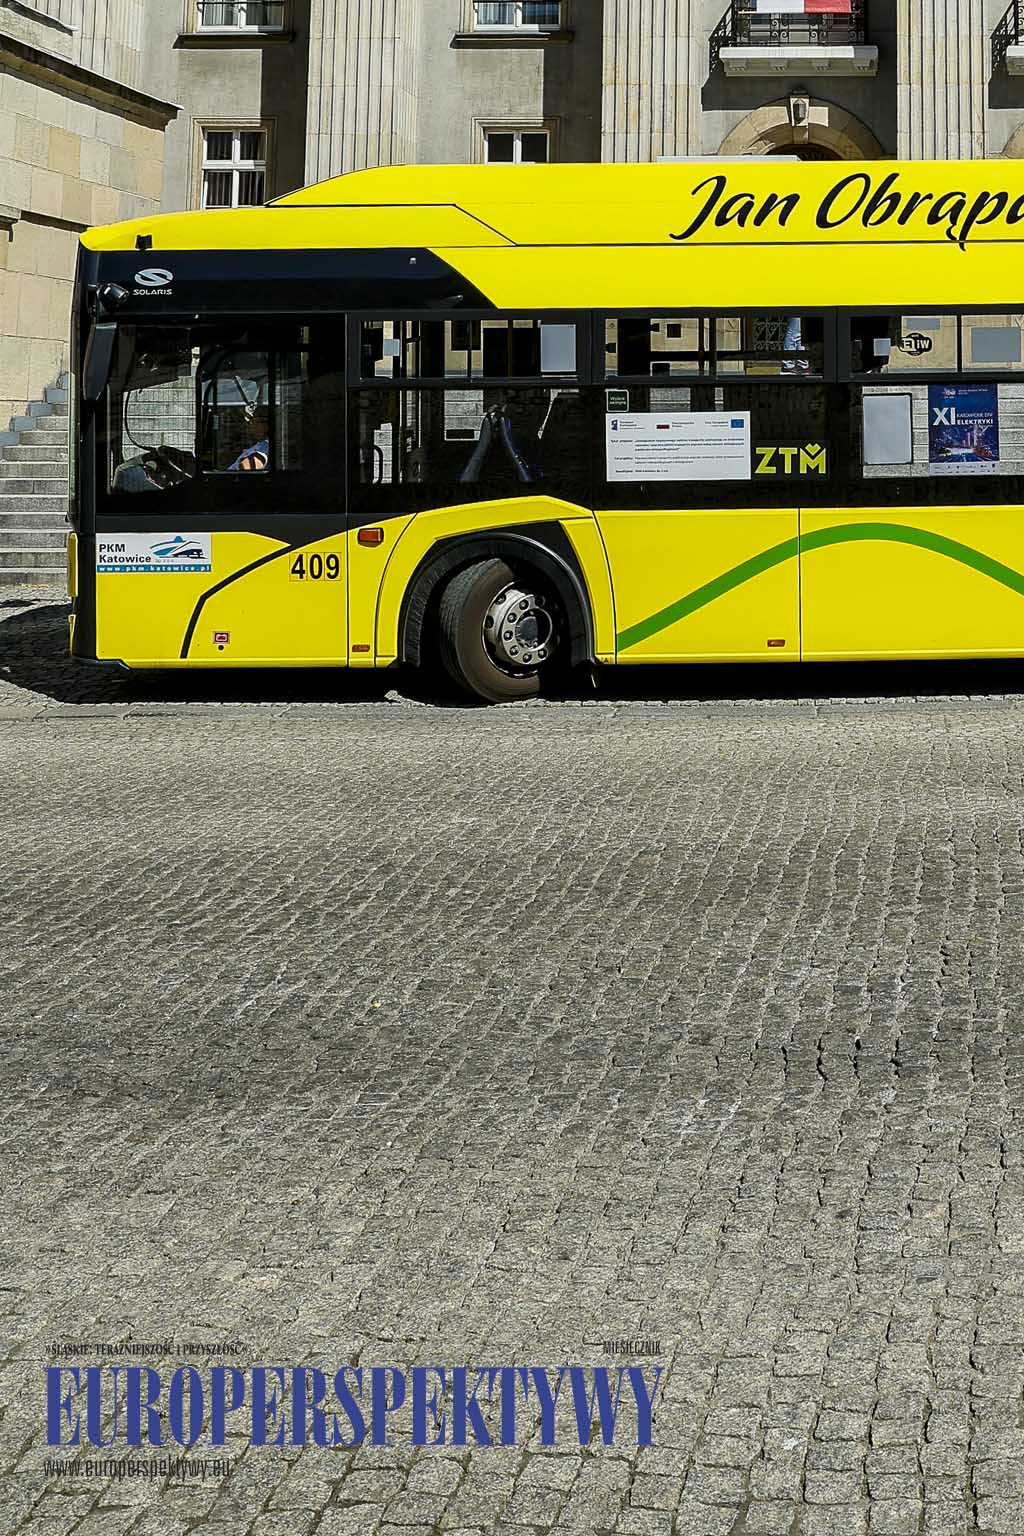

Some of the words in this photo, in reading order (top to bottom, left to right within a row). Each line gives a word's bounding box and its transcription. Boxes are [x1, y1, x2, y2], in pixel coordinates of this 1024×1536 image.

[669, 175, 800, 241] Jan
[133, 288, 173, 296] SOLARIS
[932, 407, 956, 426] XI
[754, 444, 826, 474] ZTM
[99, 544, 126, 553] PKM
[99, 554, 152, 563] Katowice
[291, 553, 340, 579] 409
